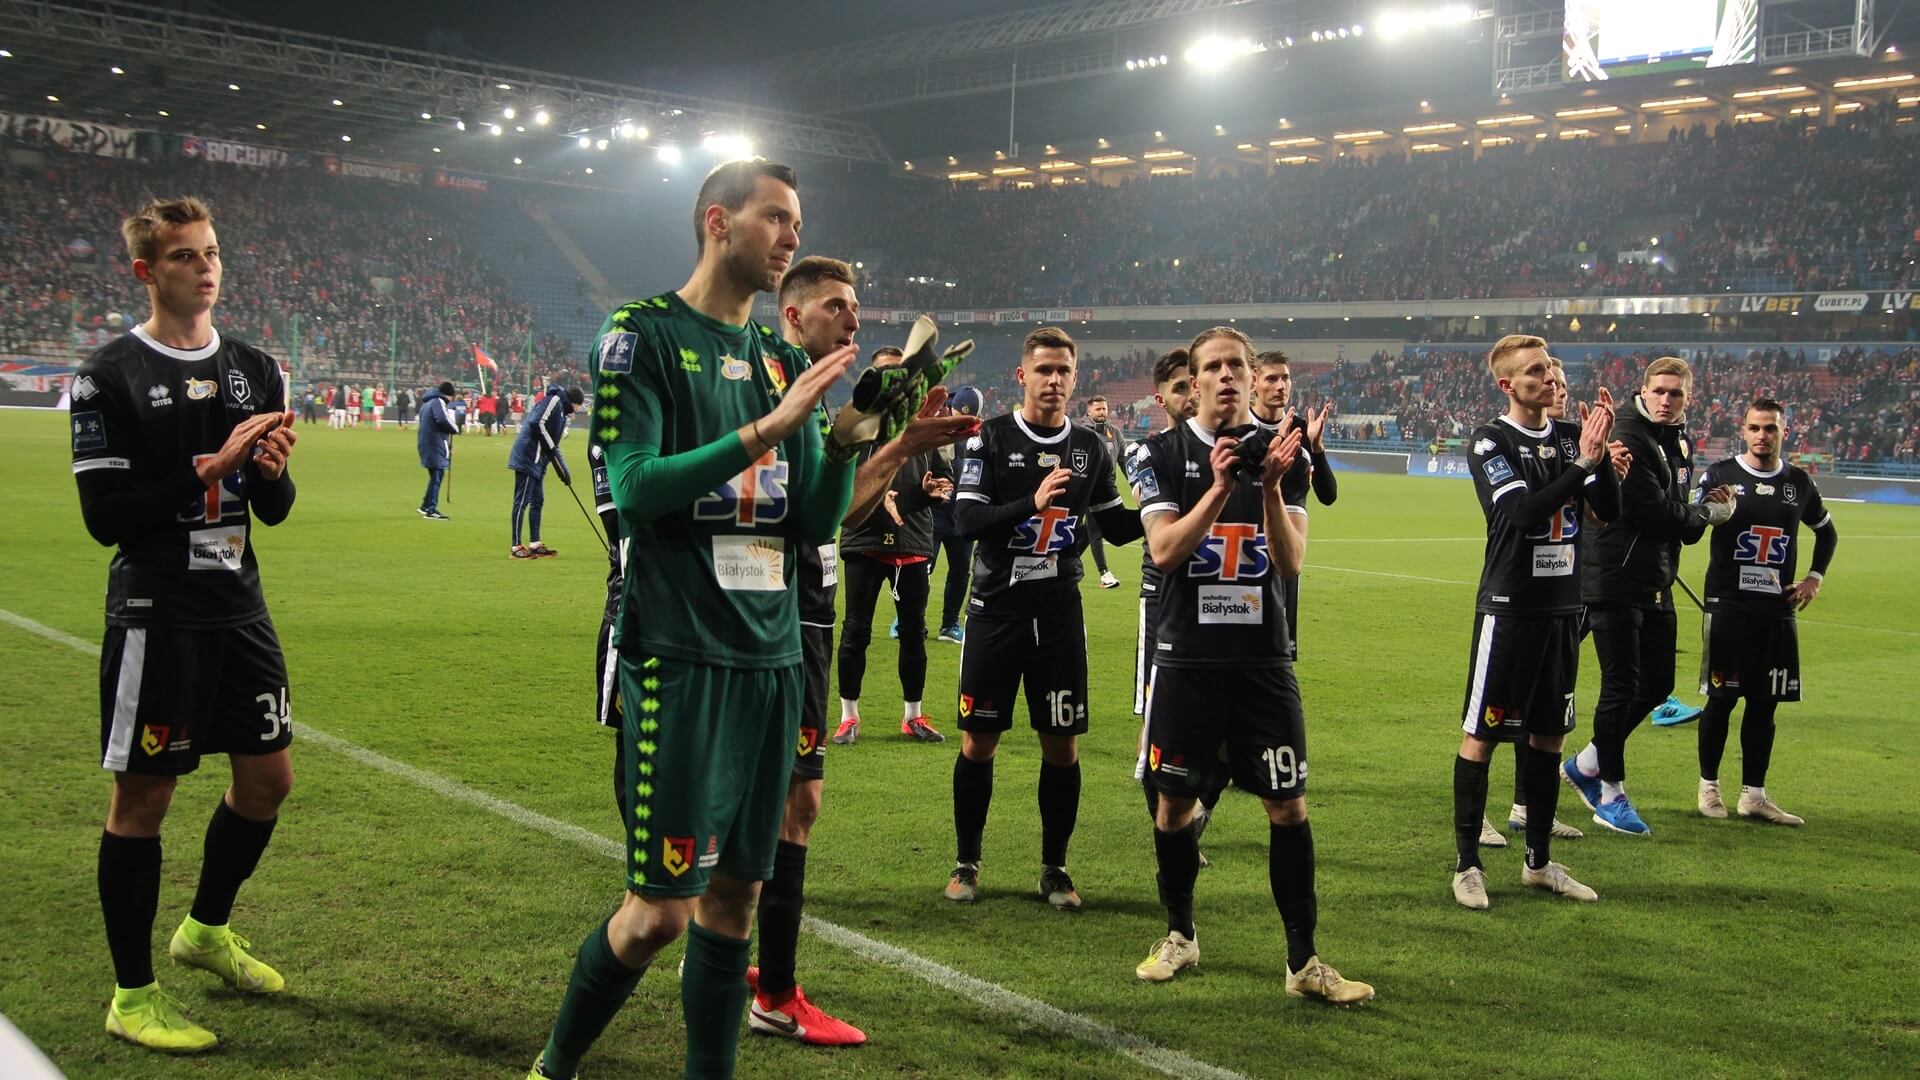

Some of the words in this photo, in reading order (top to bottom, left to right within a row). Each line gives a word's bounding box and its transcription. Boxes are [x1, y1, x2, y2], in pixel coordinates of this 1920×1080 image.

[1740, 296, 1802, 312] LVBET
[1819, 298, 1864, 307] LVBET.PL
[883, 533, 895, 545] 25
[1007, 506, 1078, 555] STS
[1188, 523, 1270, 581] STS
[1733, 525, 1790, 565] STS
[717, 563, 766, 579] Białystok
[1535, 559, 1569, 570] Białystok
[1202, 602, 1250, 616] Białystok
[1768, 668, 1788, 695] 11
[256, 687, 291, 741] 34
[1046, 690, 1074, 727] 16
[1262, 745, 1297, 790] 19
